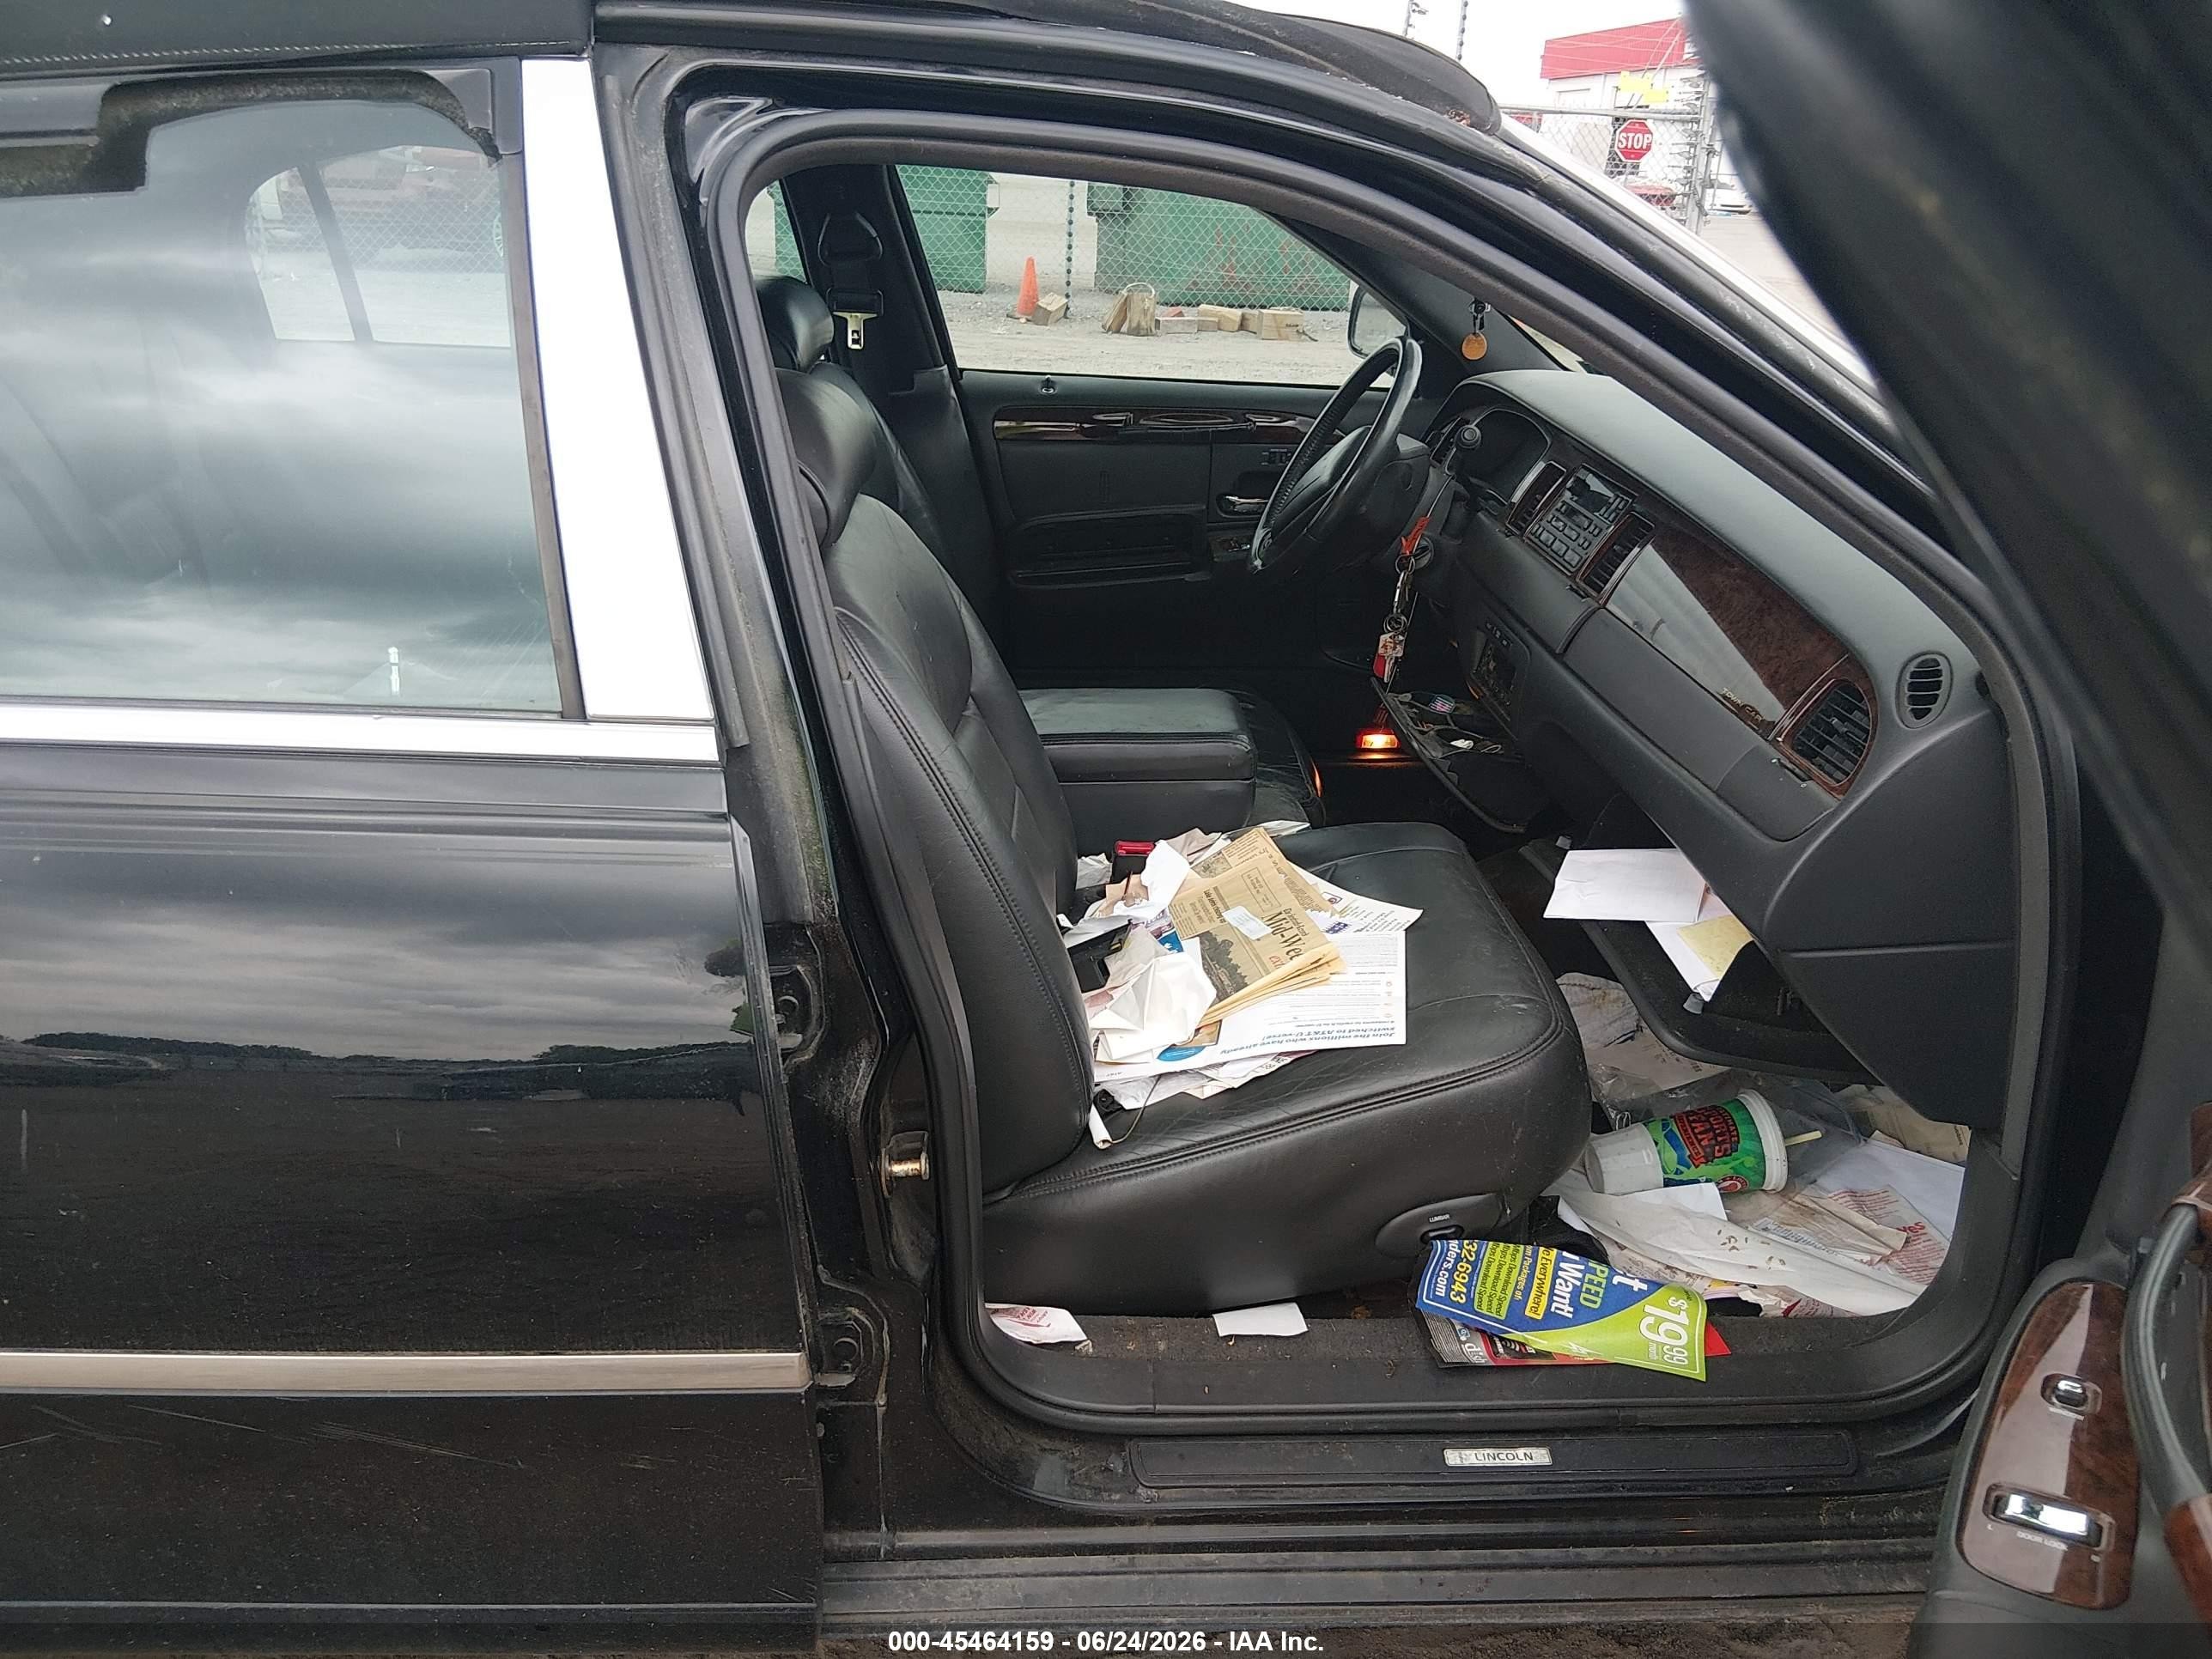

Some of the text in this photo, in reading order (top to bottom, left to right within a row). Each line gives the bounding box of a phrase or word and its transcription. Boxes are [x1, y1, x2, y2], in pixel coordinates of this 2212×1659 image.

[1618, 132, 1652, 149] STOP
[1219, 1042, 1258, 1054] already
[1480, 1257, 1495, 1289] Download
[1490, 1259, 1506, 1291] Download
[1500, 1263, 1516, 1295] Download
[1516, 1256, 1532, 1290] Packages
[1529, 1257, 1553, 1316] Everywhere!
[1580, 1261, 1609, 1310] PEED
[1476, 1288, 1486, 1310] Speed
[1486, 1291, 1497, 1314] Speed
[1496, 1294, 1507, 1317] Speed
[1551, 1261, 1585, 1319] Want!
[1474, 1452, 1534, 1462] LINCOLN
